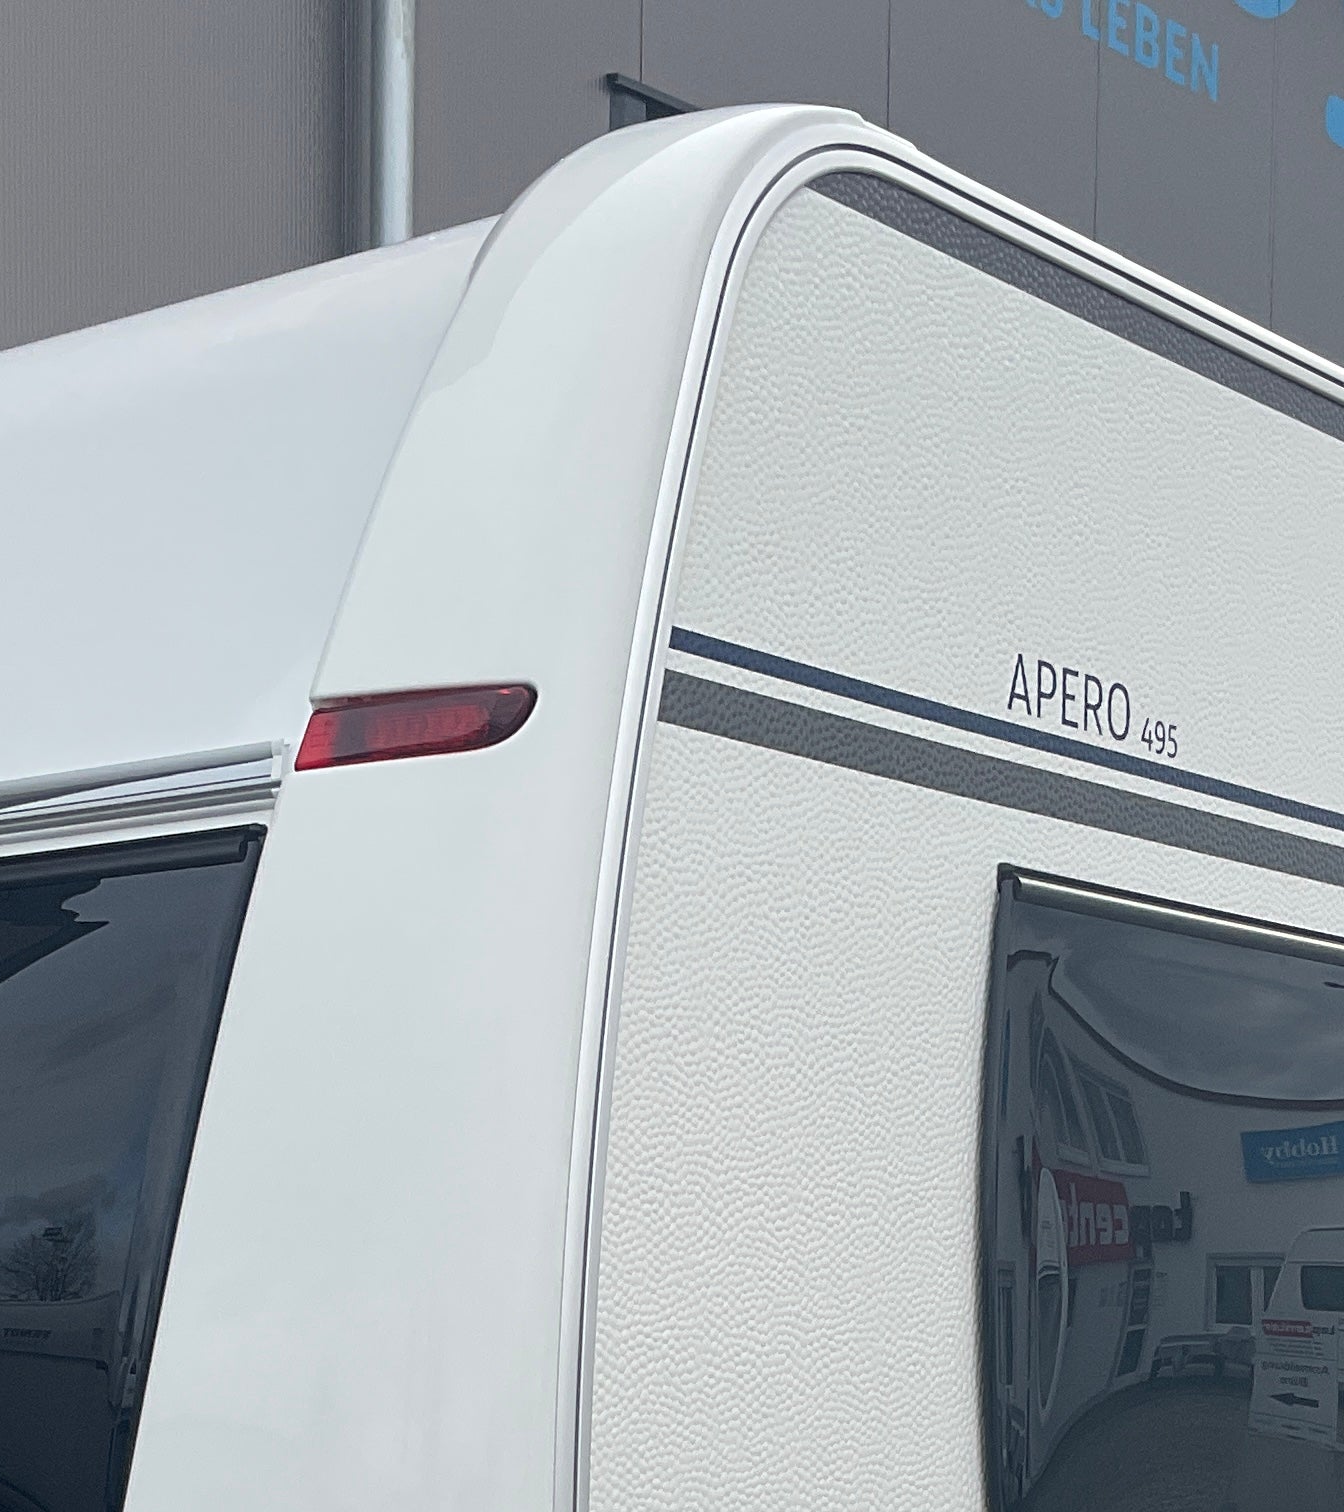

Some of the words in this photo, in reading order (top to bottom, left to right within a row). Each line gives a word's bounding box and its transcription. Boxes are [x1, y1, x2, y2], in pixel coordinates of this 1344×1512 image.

[1082, 0, 1220, 102] LEBEN
[1007, 653, 1131, 741] APERO
[1141, 717, 1178, 759] 495
